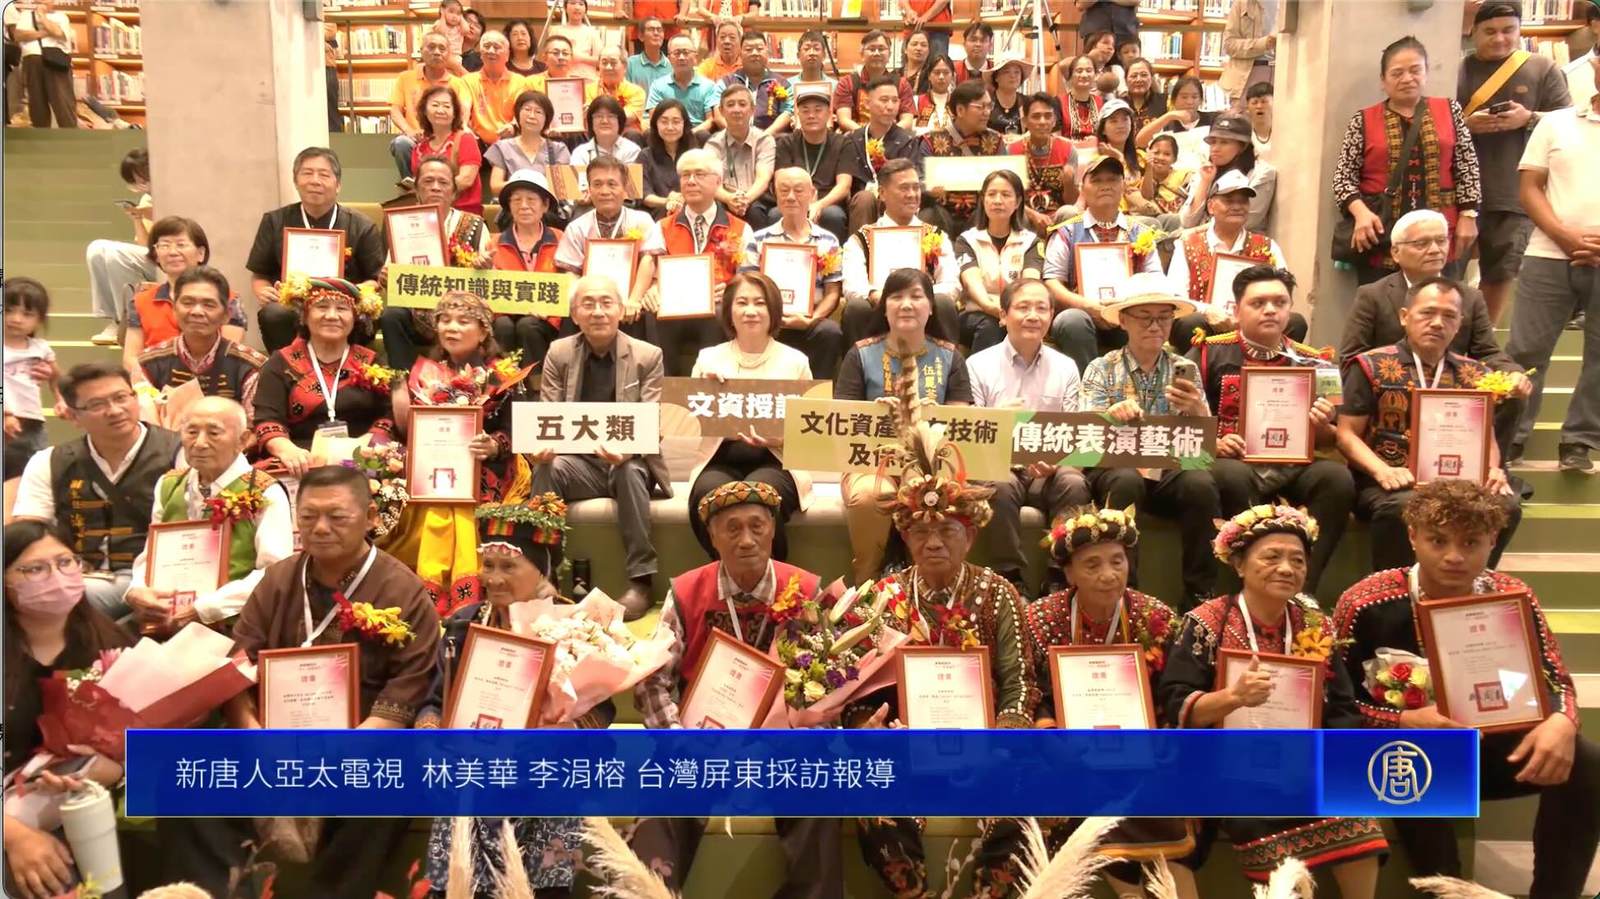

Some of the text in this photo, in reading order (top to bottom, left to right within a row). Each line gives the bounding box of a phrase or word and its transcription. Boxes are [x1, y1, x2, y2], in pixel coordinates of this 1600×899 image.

[396, 272, 560, 305] 傳統知識與實踐
[536, 414, 635, 441] 五大類
[800, 411, 998, 444] 文化資產技術
[1012, 421, 1204, 458] 傳統表演藝術
